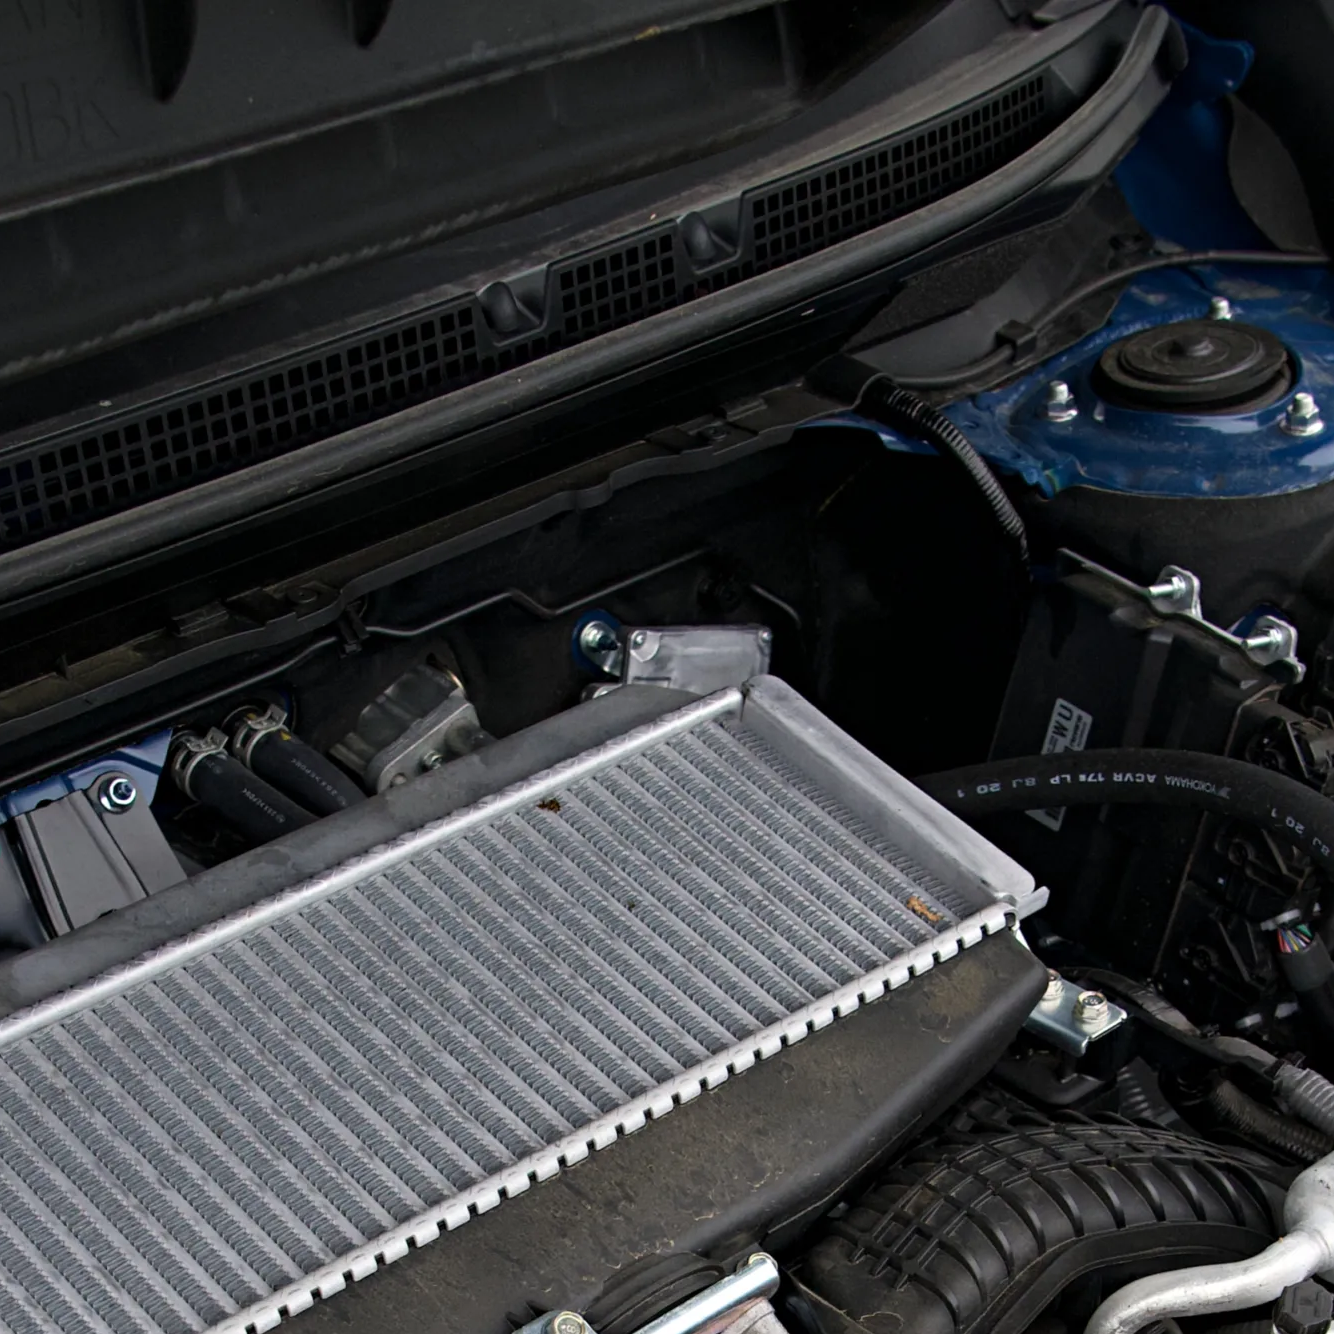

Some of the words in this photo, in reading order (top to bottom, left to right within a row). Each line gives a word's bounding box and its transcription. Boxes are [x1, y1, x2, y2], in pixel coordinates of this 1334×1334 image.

[1051, 703, 1075, 738] WU
[1049, 773, 1071, 785] LP
[1113, 771, 1157, 784] ACVR
[976, 782, 1001, 795] 20
[1163, 775, 1216, 794] YOKOHAMA
